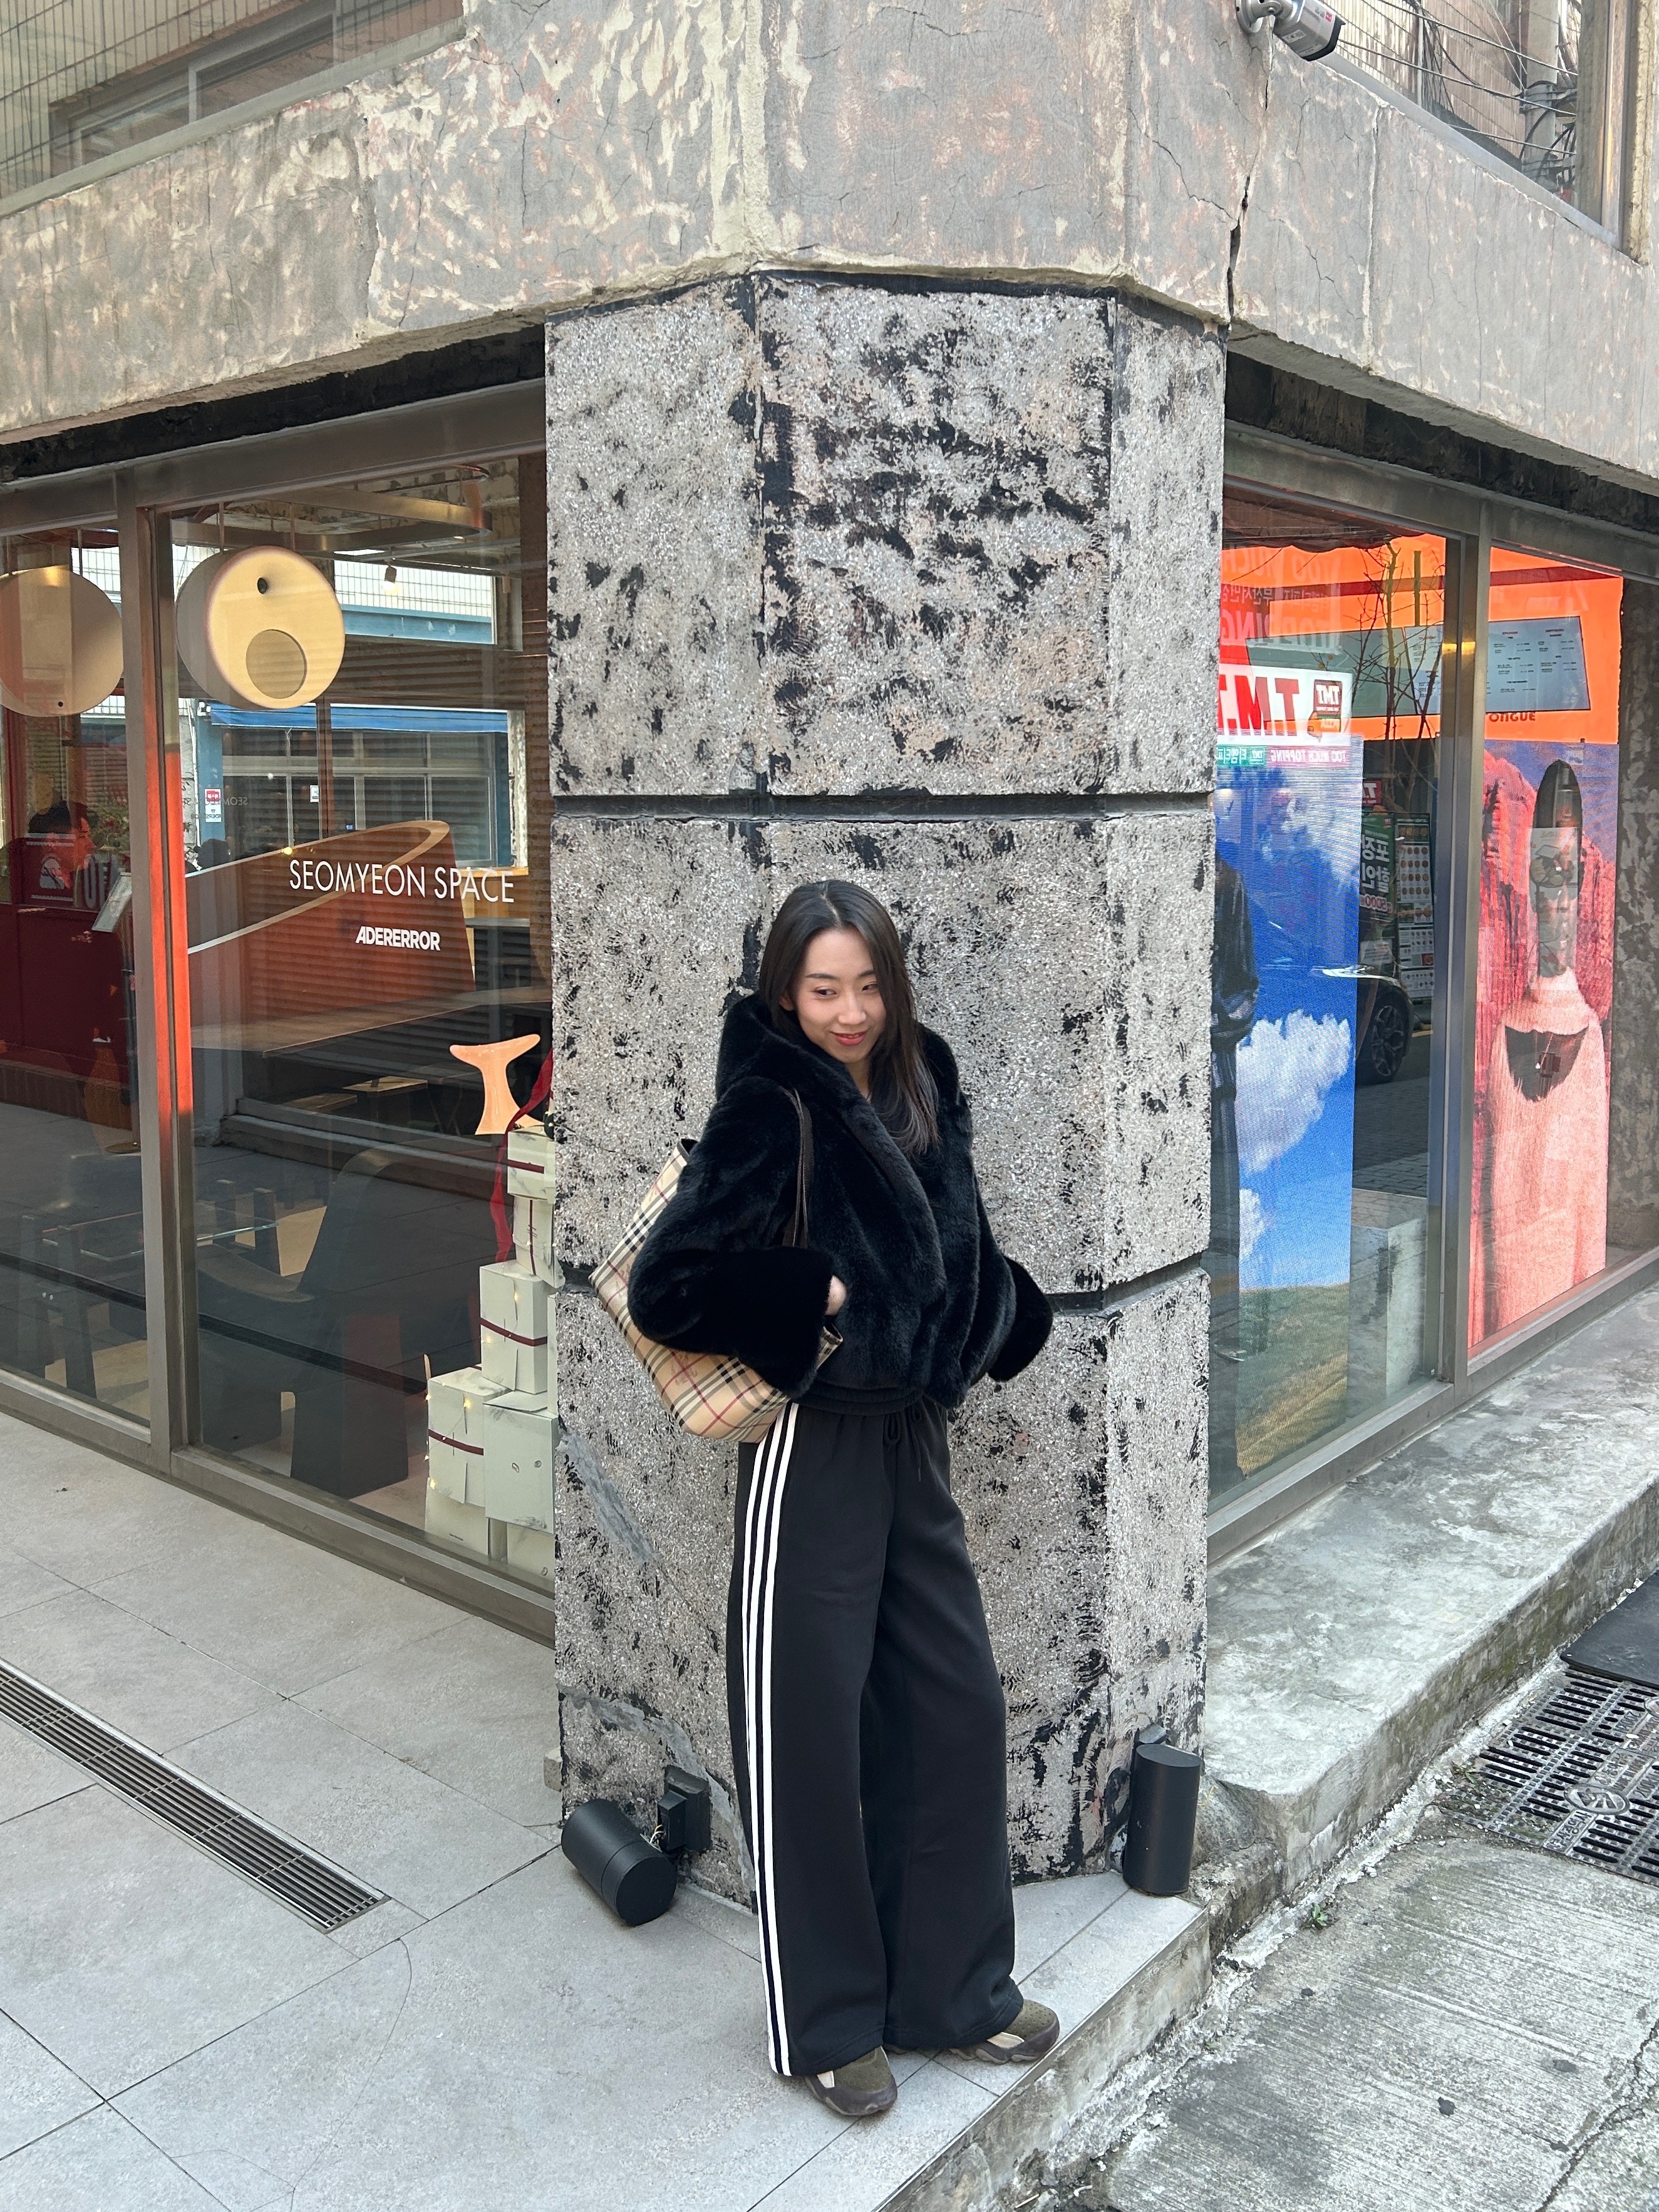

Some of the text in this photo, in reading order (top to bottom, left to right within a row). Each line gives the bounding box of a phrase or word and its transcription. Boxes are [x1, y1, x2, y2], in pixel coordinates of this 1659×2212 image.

[289, 859, 515, 904] SEOMYEON SPACE
[355, 926, 441, 951] ADERERROR
